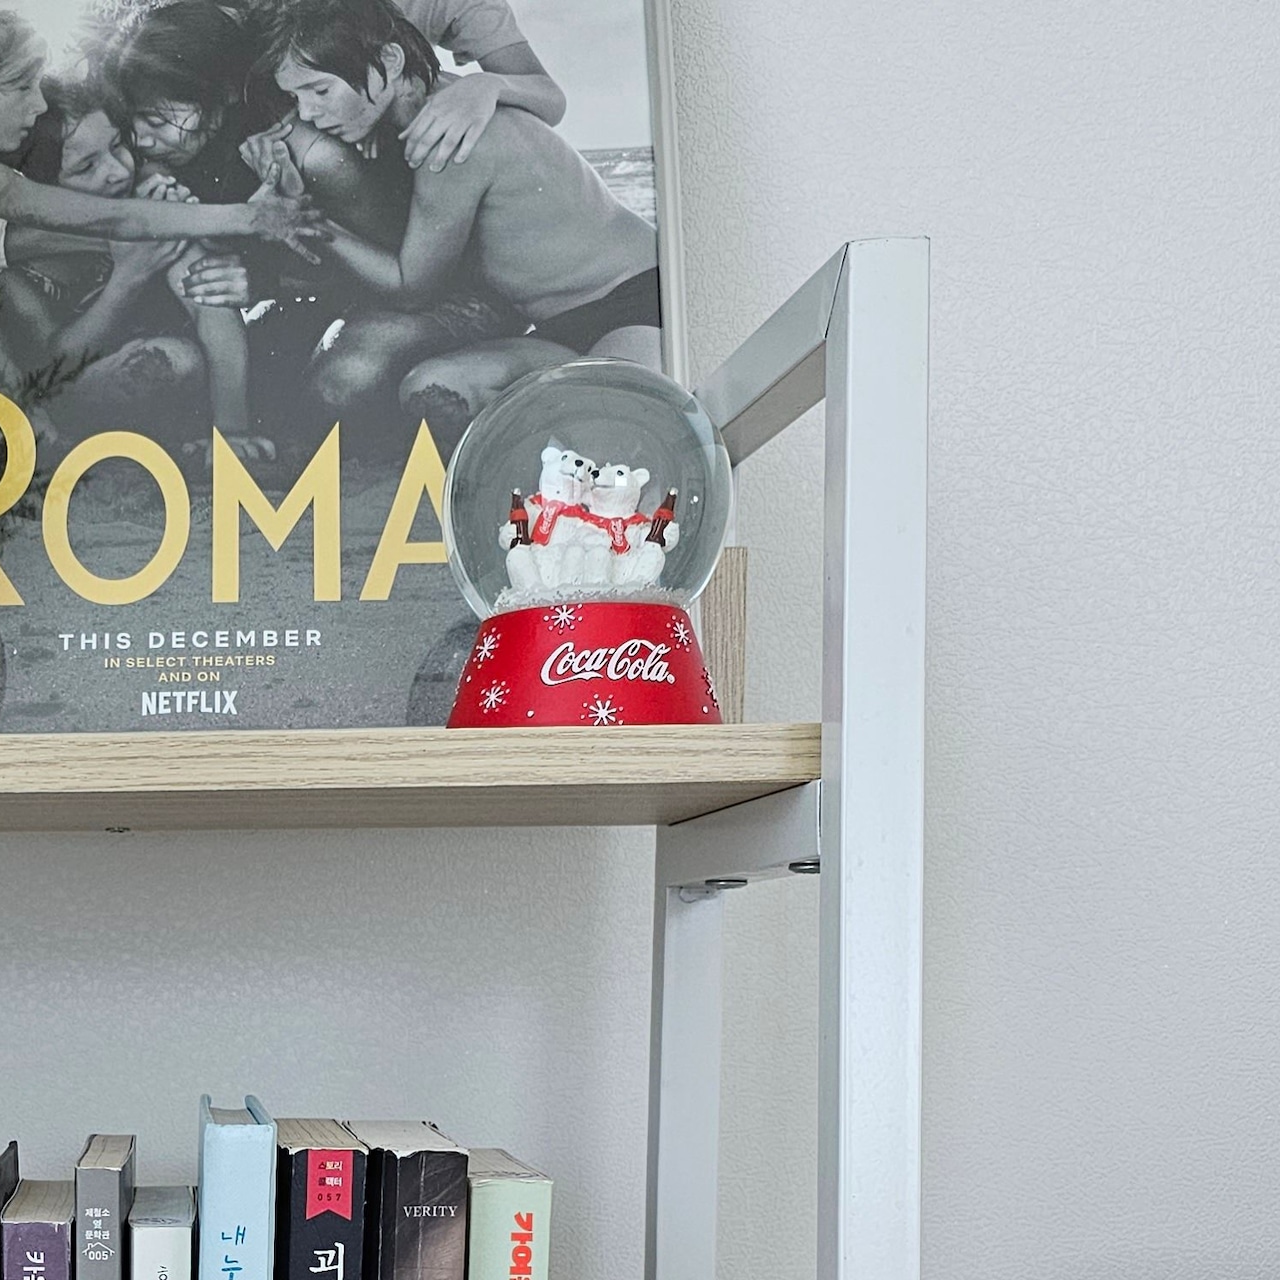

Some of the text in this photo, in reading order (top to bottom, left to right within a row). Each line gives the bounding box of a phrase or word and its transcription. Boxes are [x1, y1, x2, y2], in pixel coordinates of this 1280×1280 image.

[59, 629, 322, 650] THIS DECEMBER
[104, 655, 276, 668] IN SELECT THEATERS
[158, 671, 221, 683] AND ON
[141, 690, 238, 716] NETFLIX
[403, 1205, 458, 1218] VERITY
[221, 1225, 247, 1246] 내
[88, 1250, 109, 1261] 005
